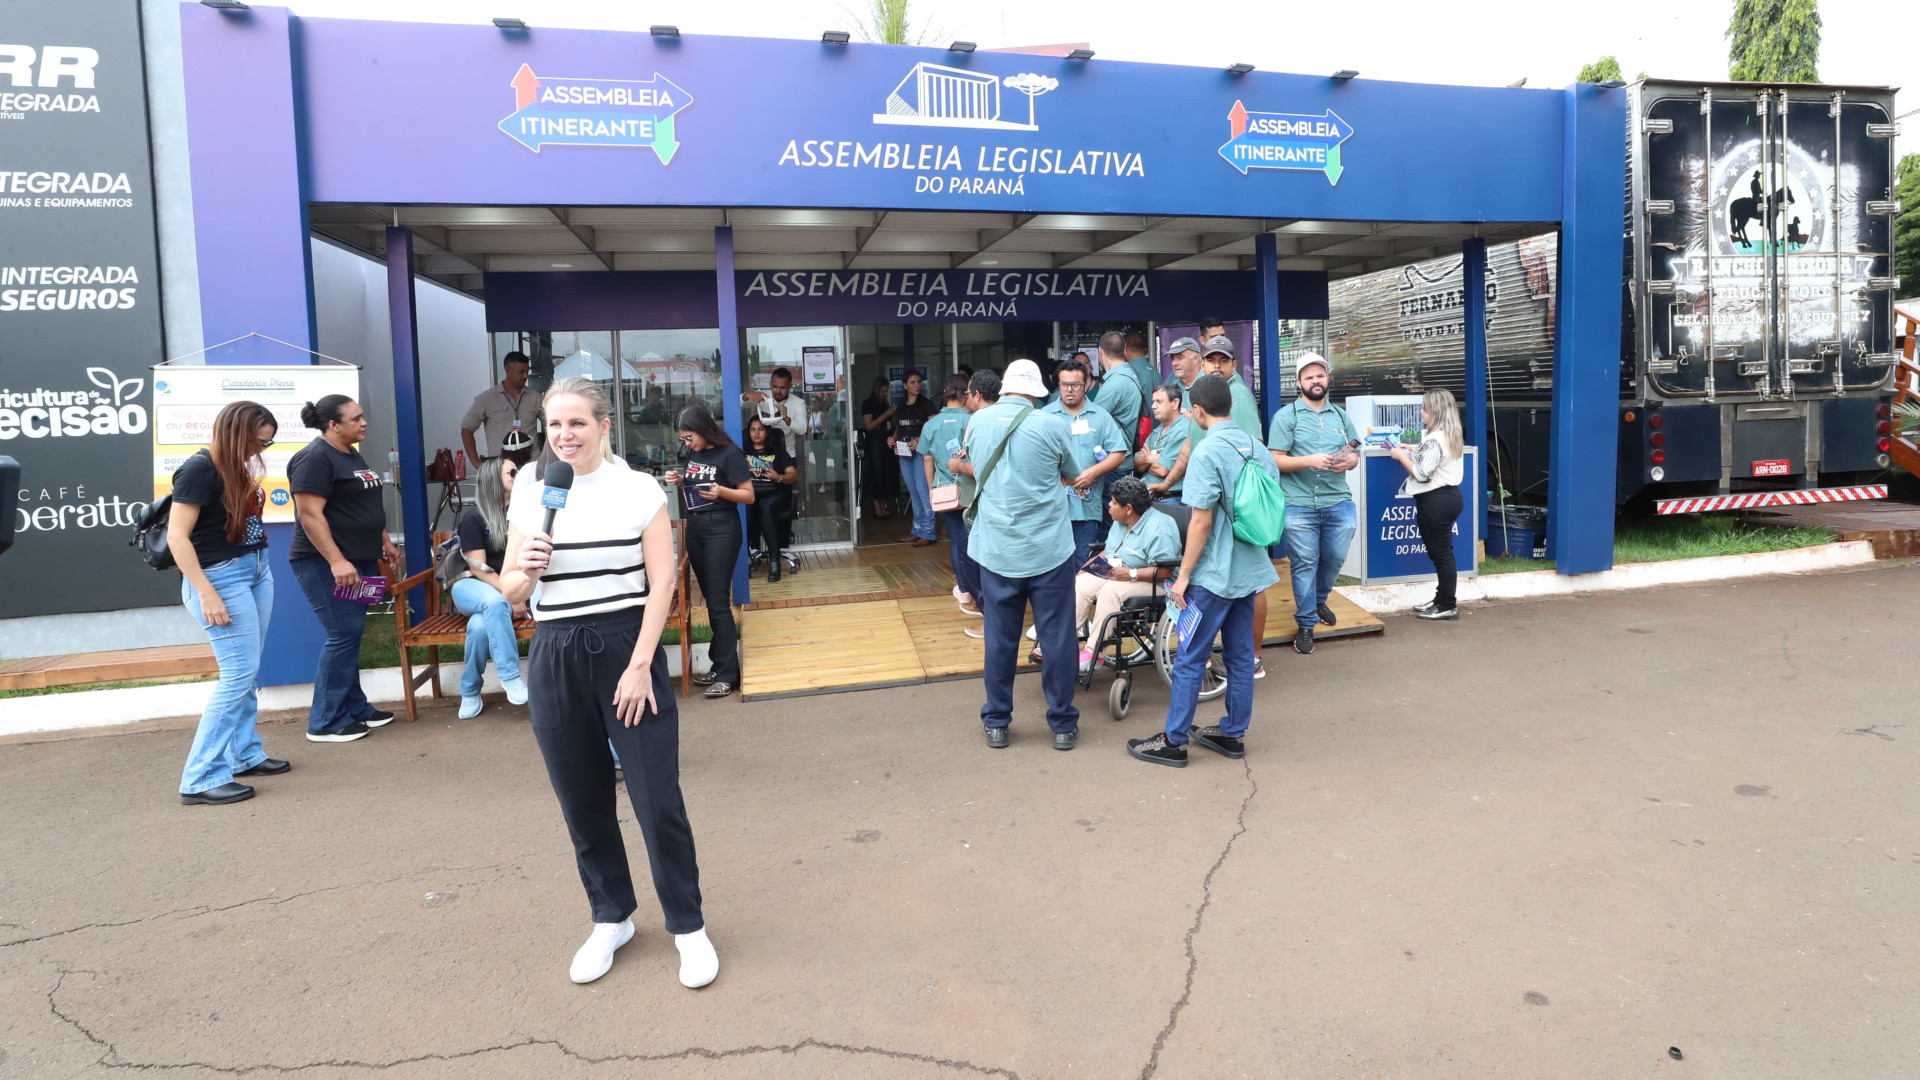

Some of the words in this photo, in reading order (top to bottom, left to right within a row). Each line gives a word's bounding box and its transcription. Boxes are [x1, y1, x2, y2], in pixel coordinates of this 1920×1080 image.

[0, 93, 100, 112] EGRADA
[541, 86, 674, 107] ASSEMBLEIA
[520, 117, 653, 138] ITINERANTE
[1248, 119, 1340, 137] ASSEMBLEIA
[778, 140, 962, 171] ASSEMBLEIA
[977, 146, 1145, 177] LEGISLATIVA
[1234, 144, 1326, 163] ITINERANTE
[915, 176, 943, 193] DO
[949, 175, 1024, 195] PARANÁ
[34, 198, 41, 207] E
[44, 198, 132, 207] EQUIPAMENTOS
[1, 266, 139, 285] INTEGRADA
[744, 272, 949, 297] ASSEMBLEIA
[966, 272, 1149, 297] LEGISLATIVA
[0, 288, 136, 311] SEGUROS
[897, 301, 927, 317] DO
[934, 298, 1018, 317] PARANÁ
[222, 378, 267, 388] Cidadania
[269, 378, 295, 388] Plena
[89, 390, 100, 398] de
[18, 484, 85, 501] CAFÉ
[1395, 546, 1409, 555] DO
